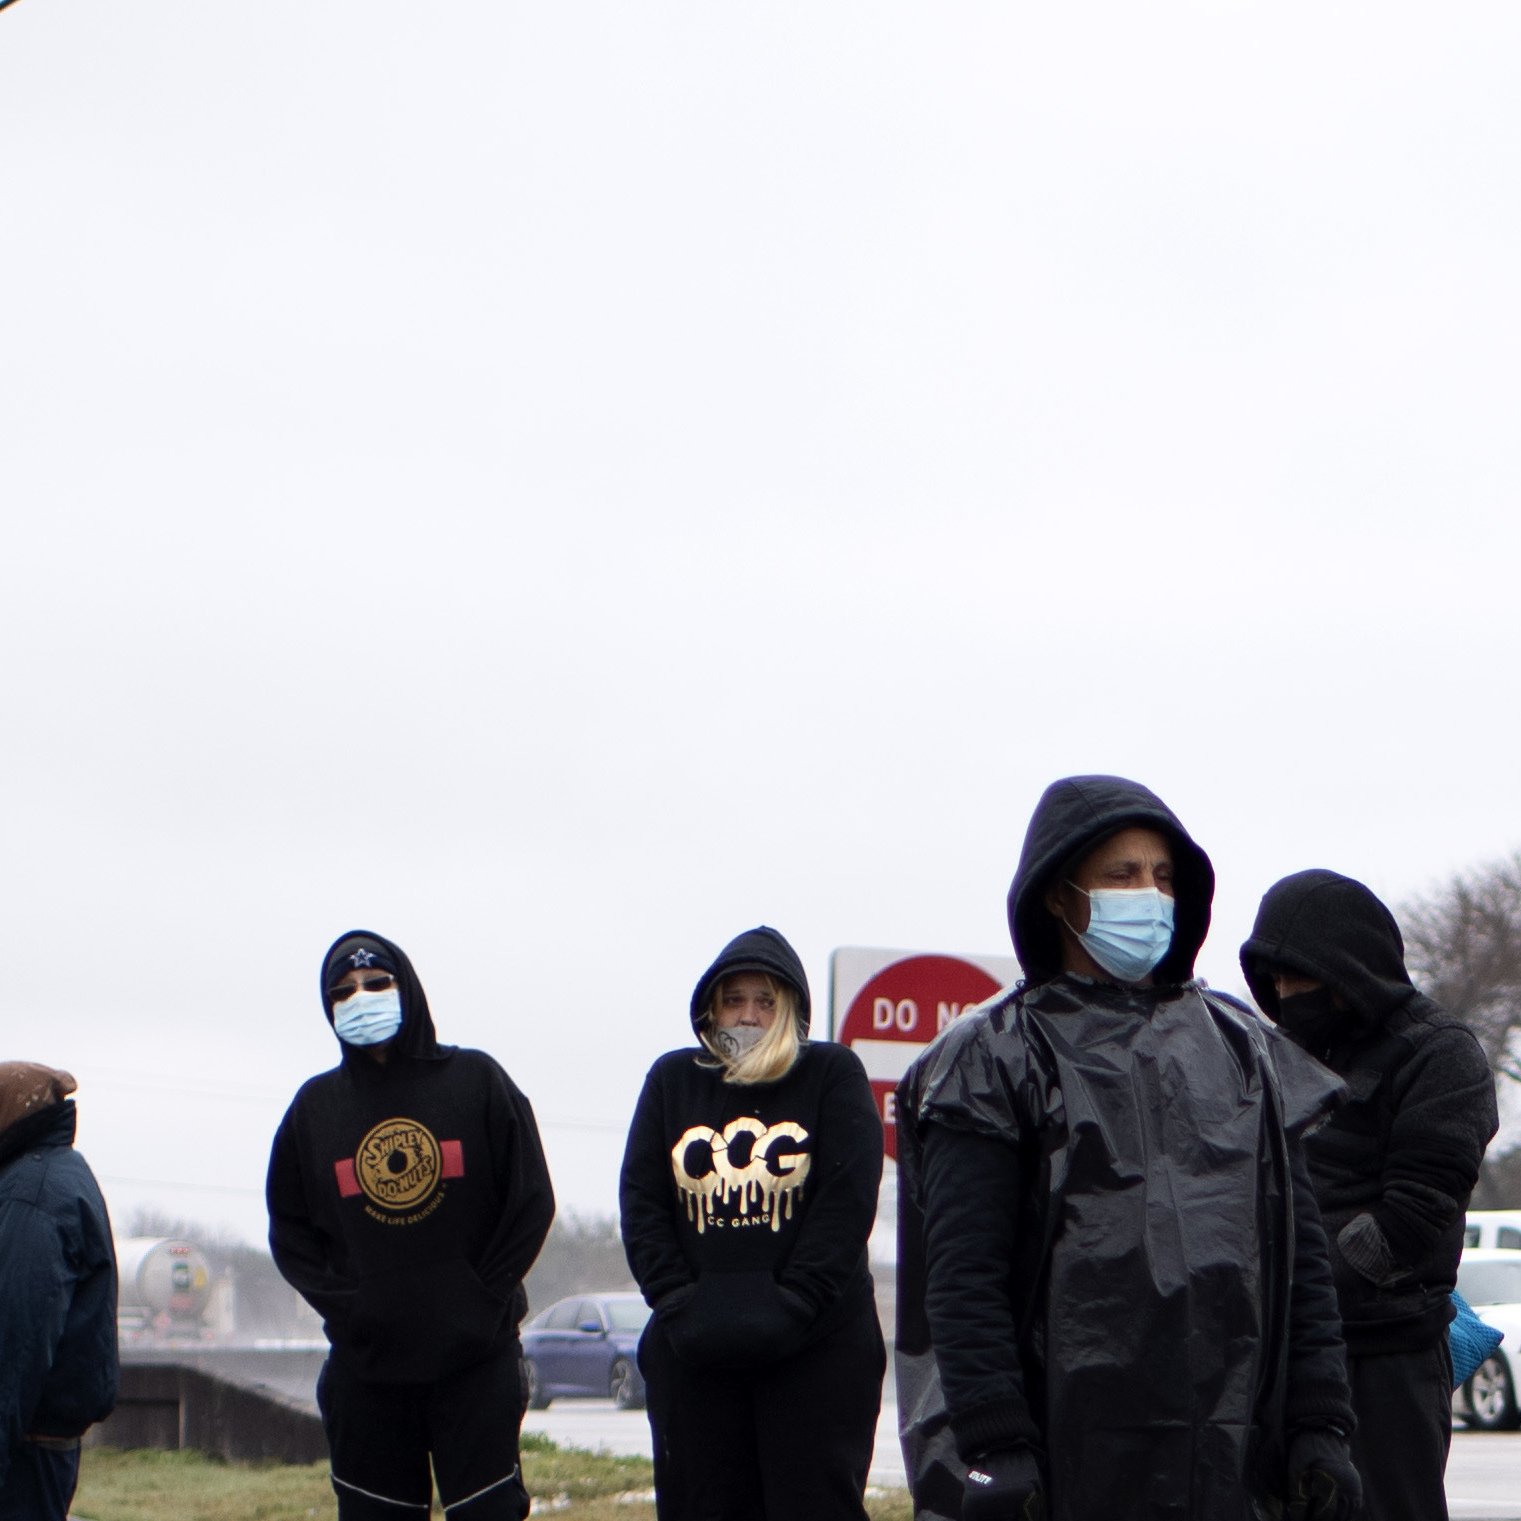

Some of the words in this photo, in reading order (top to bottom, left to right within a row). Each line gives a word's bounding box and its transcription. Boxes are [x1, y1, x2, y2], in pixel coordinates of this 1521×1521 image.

[873, 997, 918, 1032] DO
[364, 1130, 424, 1168] SHIPLEY
[672, 1116, 812, 1205] CCG
[707, 1216, 725, 1228] CC
[731, 1214, 771, 1228] GANG
